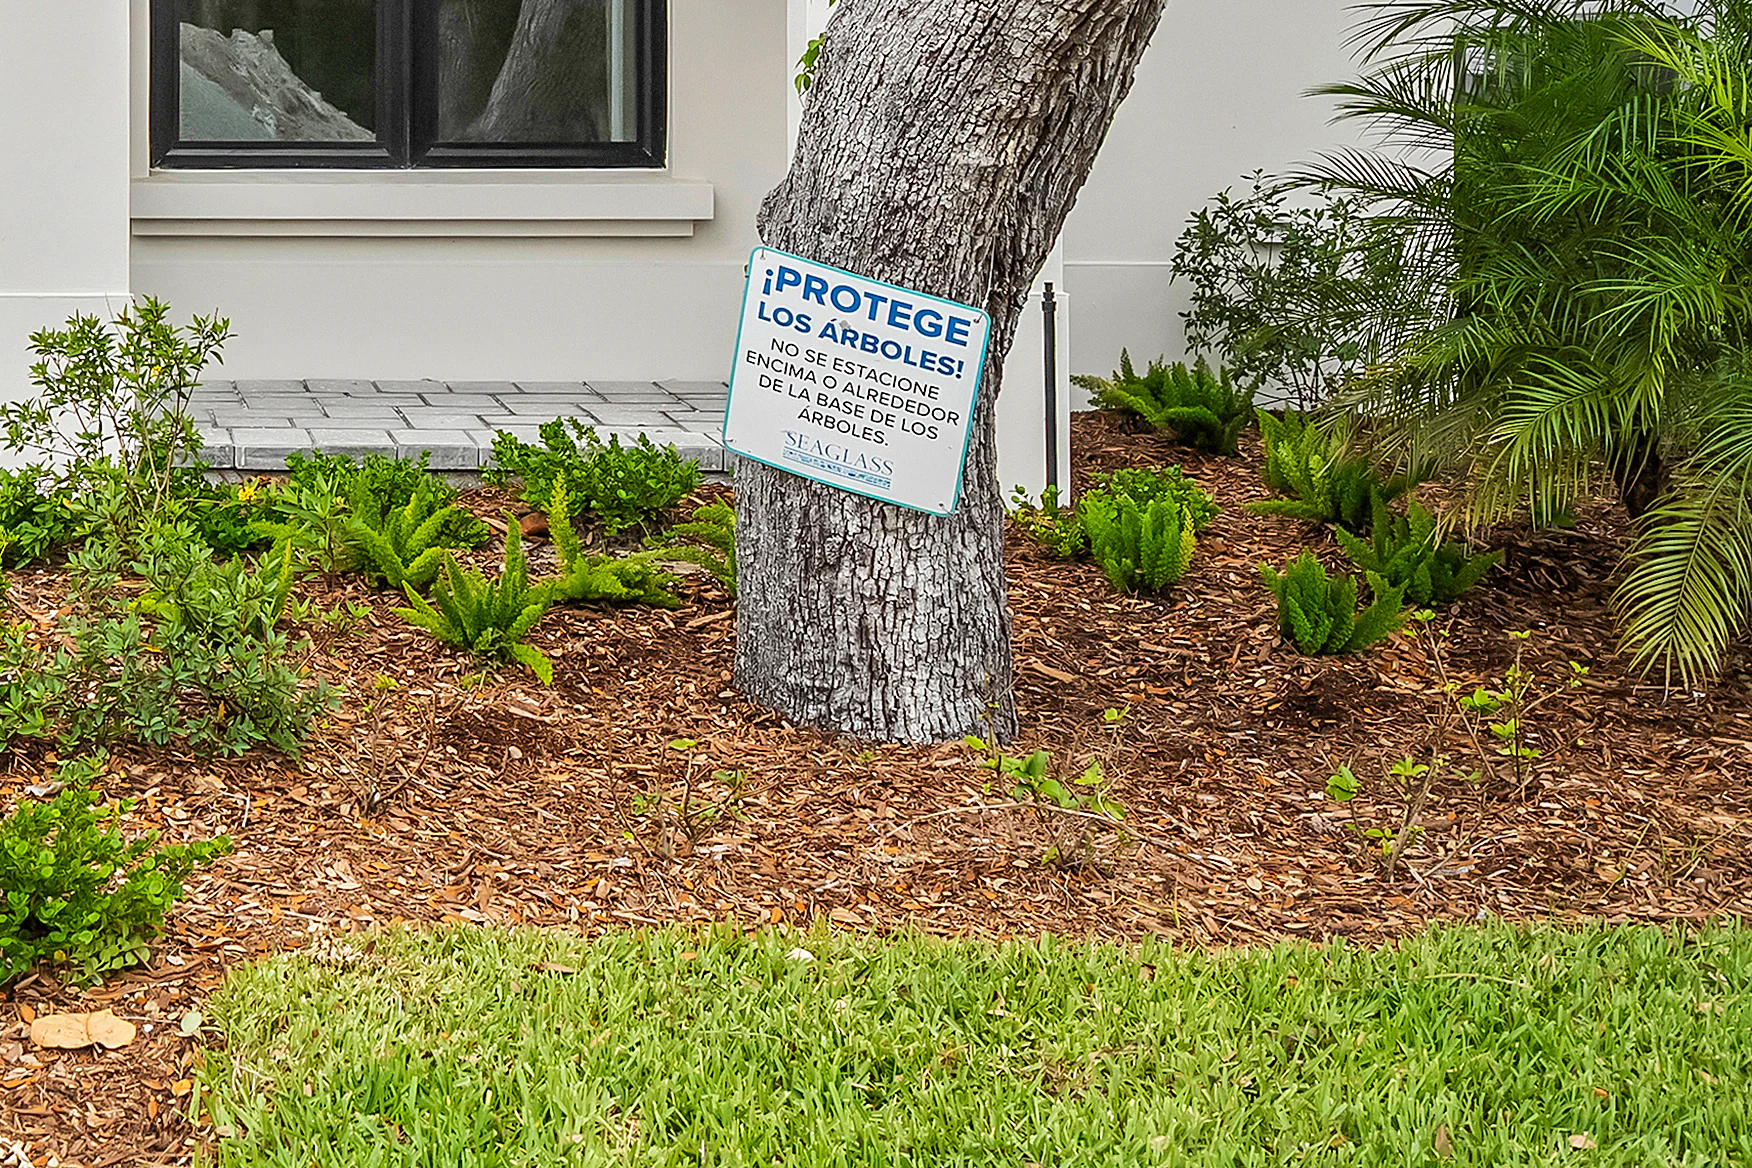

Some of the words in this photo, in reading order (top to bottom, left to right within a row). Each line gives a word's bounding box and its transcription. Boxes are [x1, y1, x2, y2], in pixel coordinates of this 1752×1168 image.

[762, 265, 971, 346] ¡PROTEGE
[758, 301, 812, 333] LOS
[818, 319, 964, 379] ÁRBOLES!
[771, 338, 799, 357] NO
[804, 349, 828, 367] SE
[833, 358, 940, 400] ESTACIONE
[746, 350, 817, 384] ENCIMA
[823, 375, 837, 389] O
[842, 381, 960, 425] ALREDEDOR
[759, 374, 783, 392] DE
[788, 383, 811, 402] LA
[817, 394, 864, 417] BASE
[871, 410, 895, 426] DE
[901, 418, 938, 439] LOS
[784, 431, 894, 475] SEAGLASS
[798, 406, 889, 446] ÁRBOLES.
